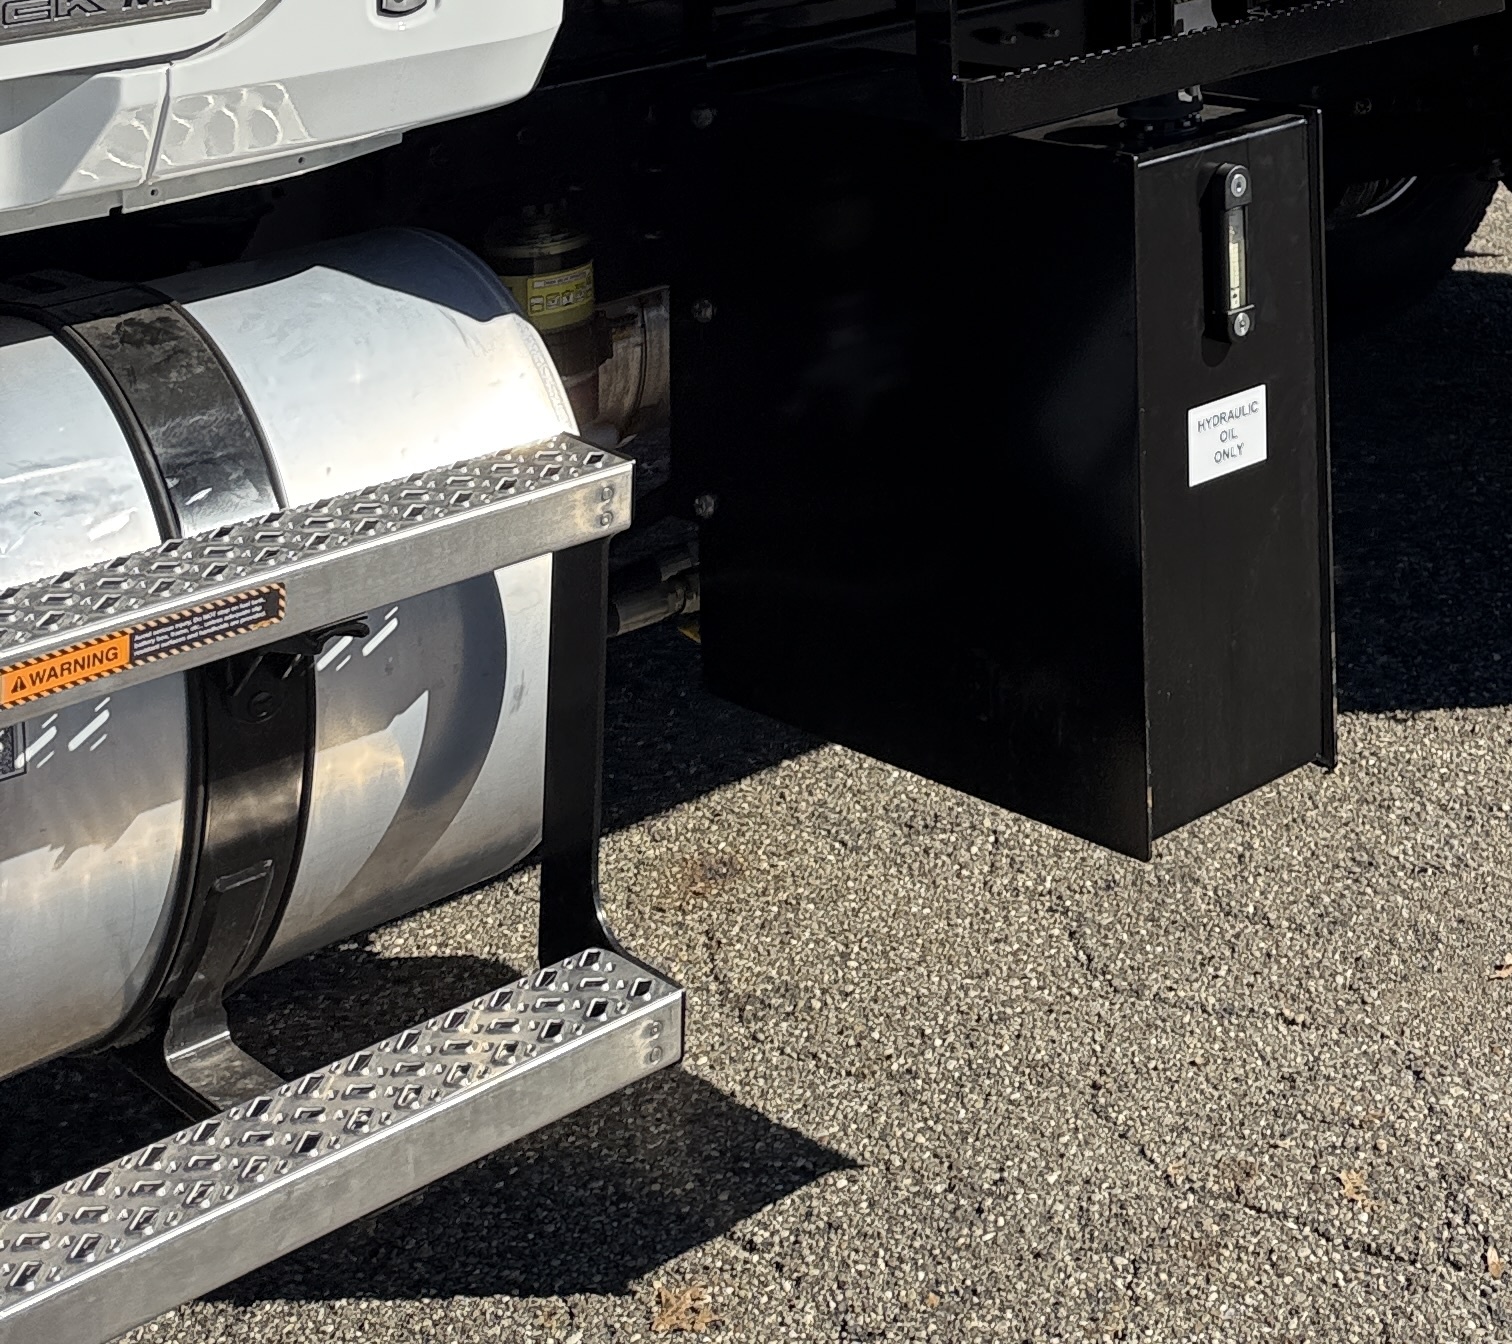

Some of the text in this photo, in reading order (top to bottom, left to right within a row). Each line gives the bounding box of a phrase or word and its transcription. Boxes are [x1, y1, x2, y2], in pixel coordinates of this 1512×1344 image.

[1198, 401, 1259, 433] HYDRAULIC
[1220, 428, 1238, 443] OIL
[1214, 442, 1244, 463] ONLY
[29, 646, 119, 687] WARNING
